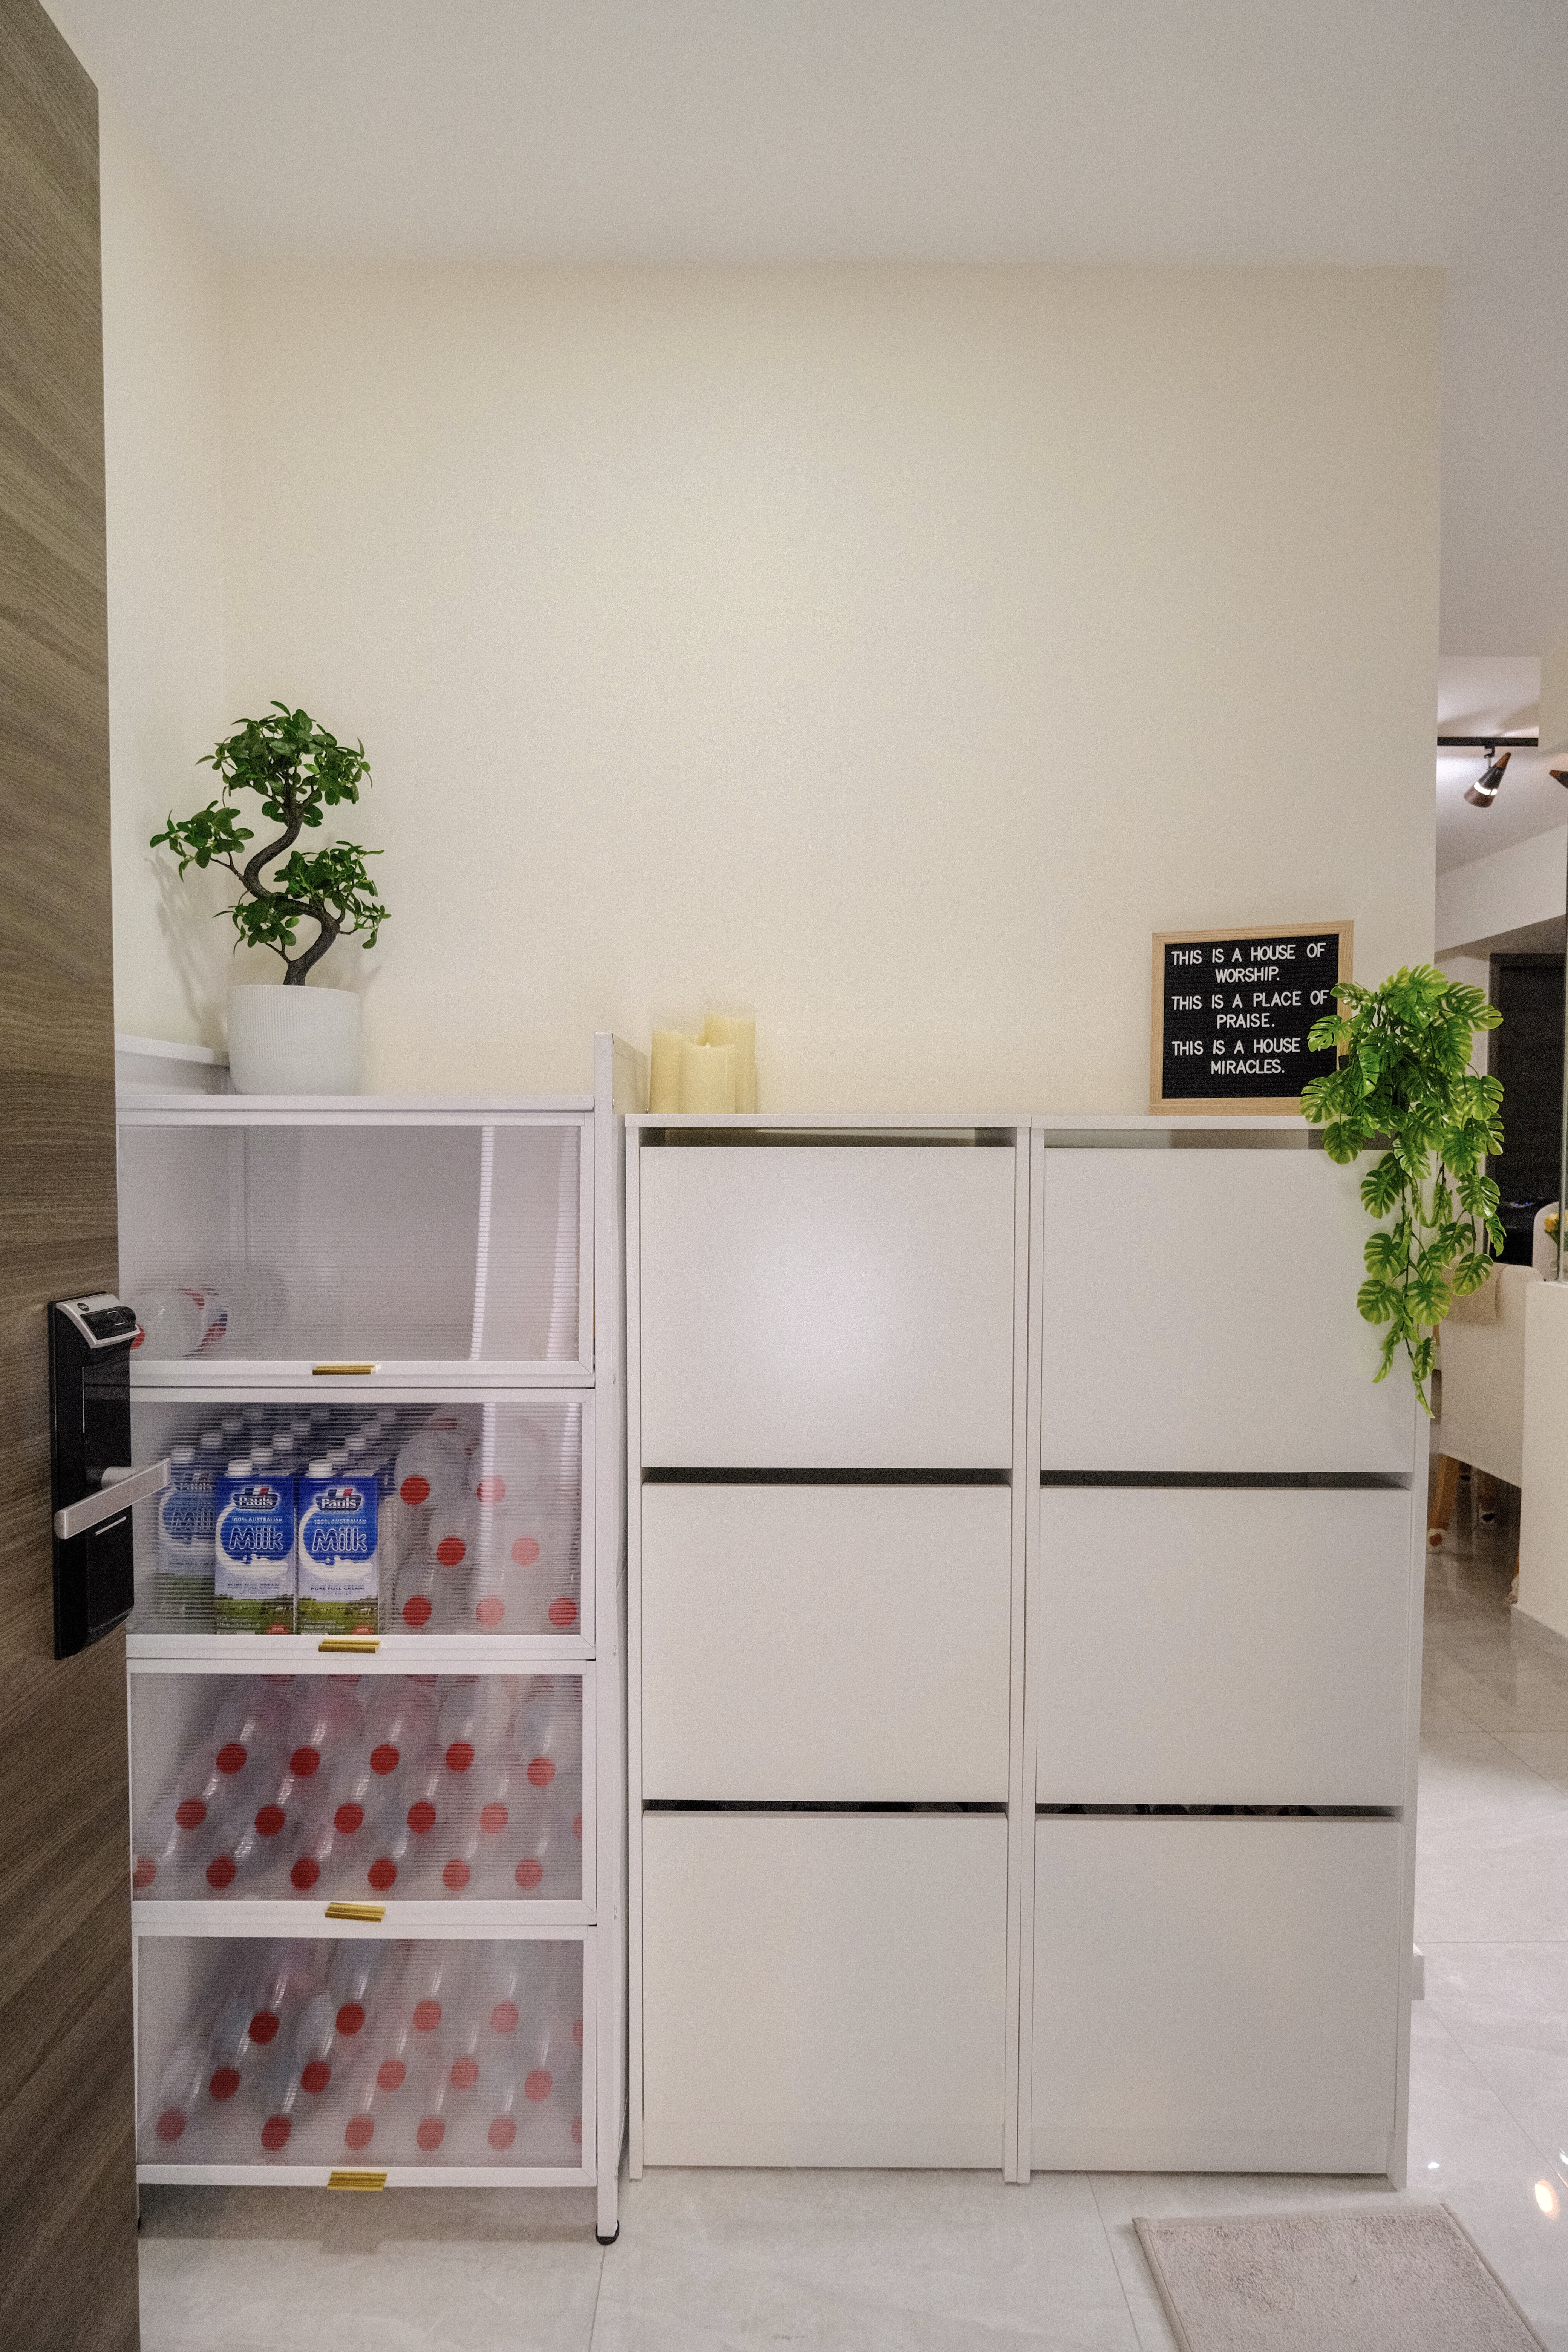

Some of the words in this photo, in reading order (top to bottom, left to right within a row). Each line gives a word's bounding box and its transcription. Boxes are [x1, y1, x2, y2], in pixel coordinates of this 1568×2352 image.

[1171, 949, 1202, 965] THIS
[1212, 948, 1224, 963] IS
[1231, 948, 1242, 962] A
[1251, 944, 1296, 961] HOUSE
[1306, 942, 1326, 958] OF
[1215, 966, 1280, 983] WORSHIP.
[1171, 995, 1202, 1011] THIS
[1211, 994, 1224, 1009] IS
[1232, 994, 1243, 1008] A
[1253, 991, 1302, 1007] PLACE
[1310, 990, 1329, 1005] OF
[1217, 1012, 1275, 1029] PRAISE.
[1171, 1040, 1204, 1056] THIS
[1213, 1040, 1225, 1055] IS
[1234, 1040, 1244, 1054] A
[1253, 1038, 1301, 1053] HOUSE
[1211, 1059, 1285, 1075] MIRACLES.
[239, 1496, 273, 1507] Pauls
[322, 1498, 357, 1508] Pauls
[229, 1525, 283, 1550] Milk
[312, 1526, 368, 1551] Milk
